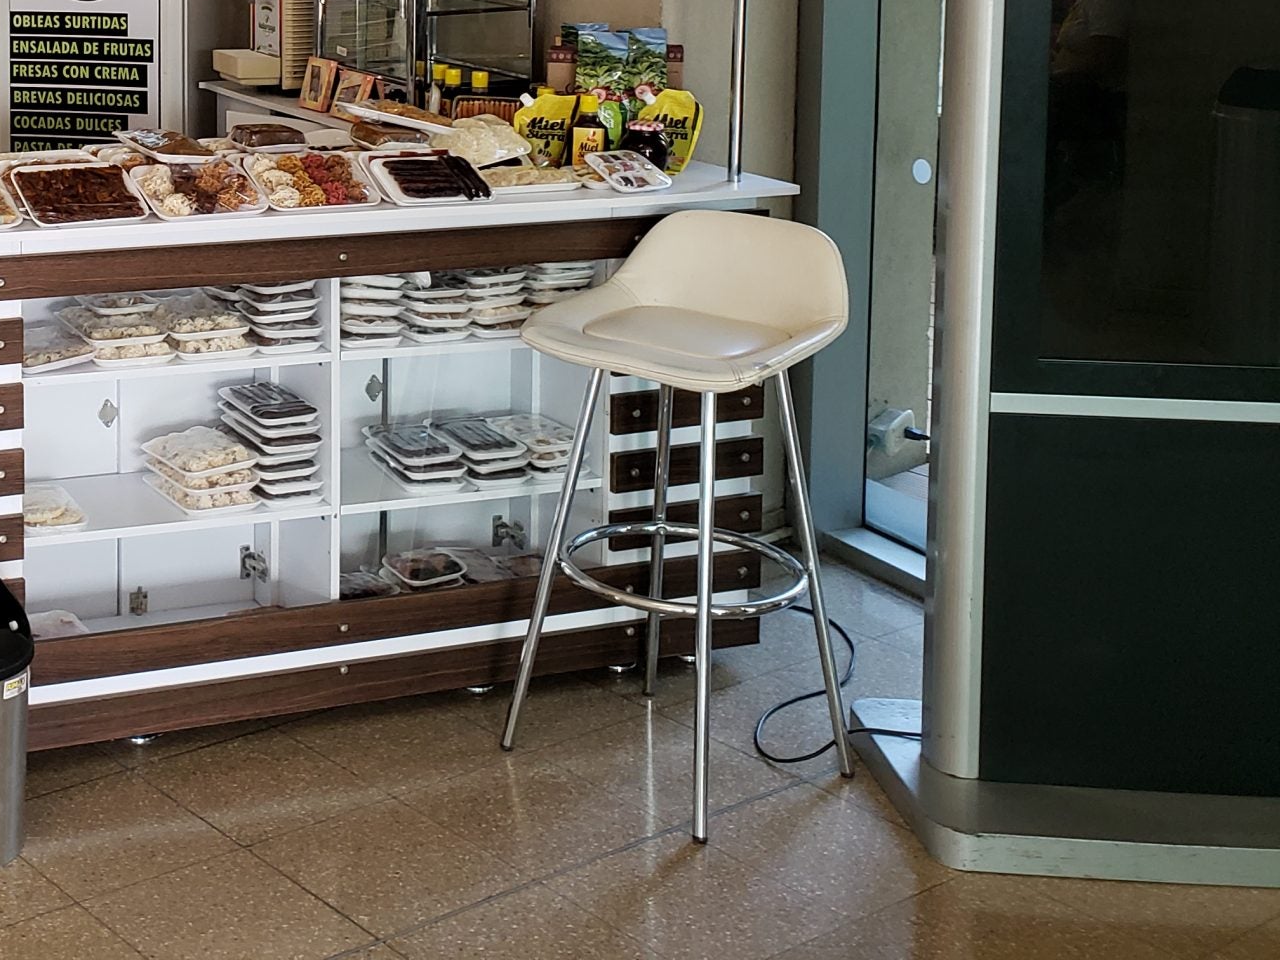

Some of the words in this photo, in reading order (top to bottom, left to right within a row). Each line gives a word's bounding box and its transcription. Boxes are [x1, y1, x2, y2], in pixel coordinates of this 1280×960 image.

[13, 14, 61, 28] OBLEAS
[65, 16, 127, 30] SURTIDAS
[12, 40, 79, 55] ENSALADA
[83, 42, 99, 55] DE
[103, 43, 152, 57] FRUTAS
[13, 64, 58, 78] FRESAS
[62, 65, 90, 79] CON
[94, 66, 140, 81] CREMA
[13, 90, 62, 104] BREVAS
[66, 92, 140, 108] DELICIOSAS
[13, 115, 71, 130] COCADAS
[76, 117, 123, 132] DULCES
[527, 117, 566, 130] Miel
[526, 130, 566, 141] Sierra
[14, 141, 54, 152] PASTA
[577, 142, 598, 152] Miel
